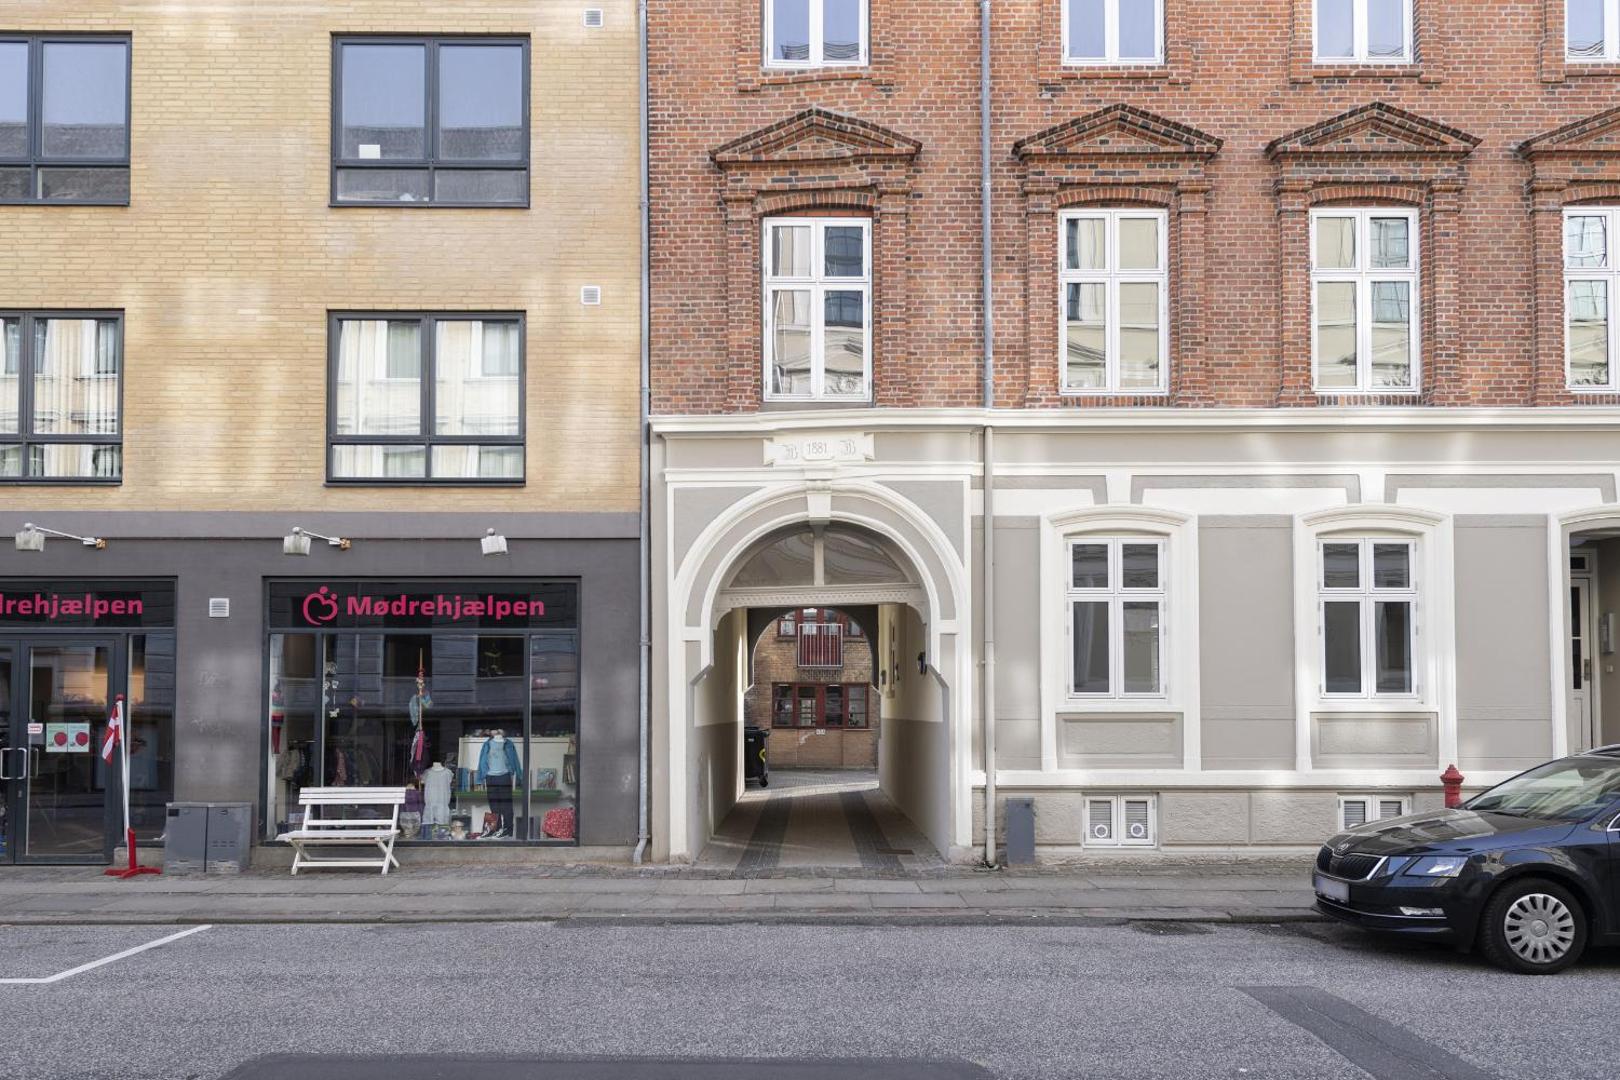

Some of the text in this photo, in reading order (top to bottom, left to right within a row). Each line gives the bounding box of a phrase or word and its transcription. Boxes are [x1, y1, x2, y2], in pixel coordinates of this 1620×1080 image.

[807, 442, 827, 455] 1881
[0, 592, 143, 618] rehjælpen
[346, 594, 545, 620] Mødrehjælpen
